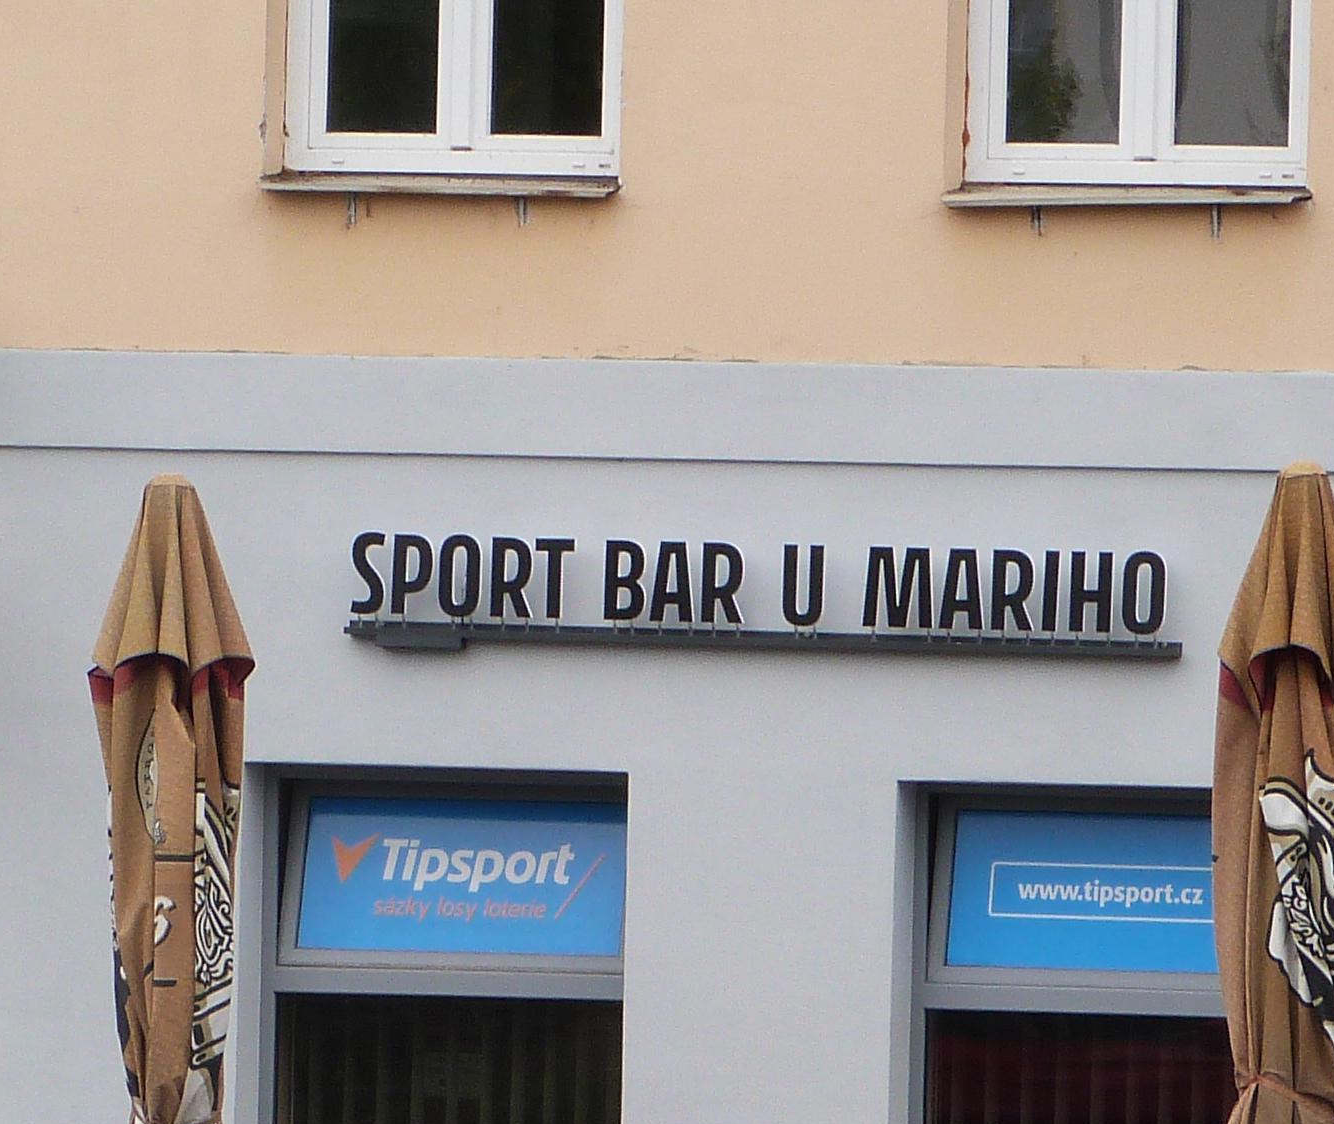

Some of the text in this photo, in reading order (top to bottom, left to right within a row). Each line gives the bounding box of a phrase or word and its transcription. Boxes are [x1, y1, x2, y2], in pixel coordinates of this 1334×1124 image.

[349, 531, 1168, 636] SPORT BAR U MARIHO
[382, 837, 575, 893] Tipsport
[372, 896, 547, 921] sázky losy loterie
[1018, 879, 1203, 908] www.tipsport.cz
